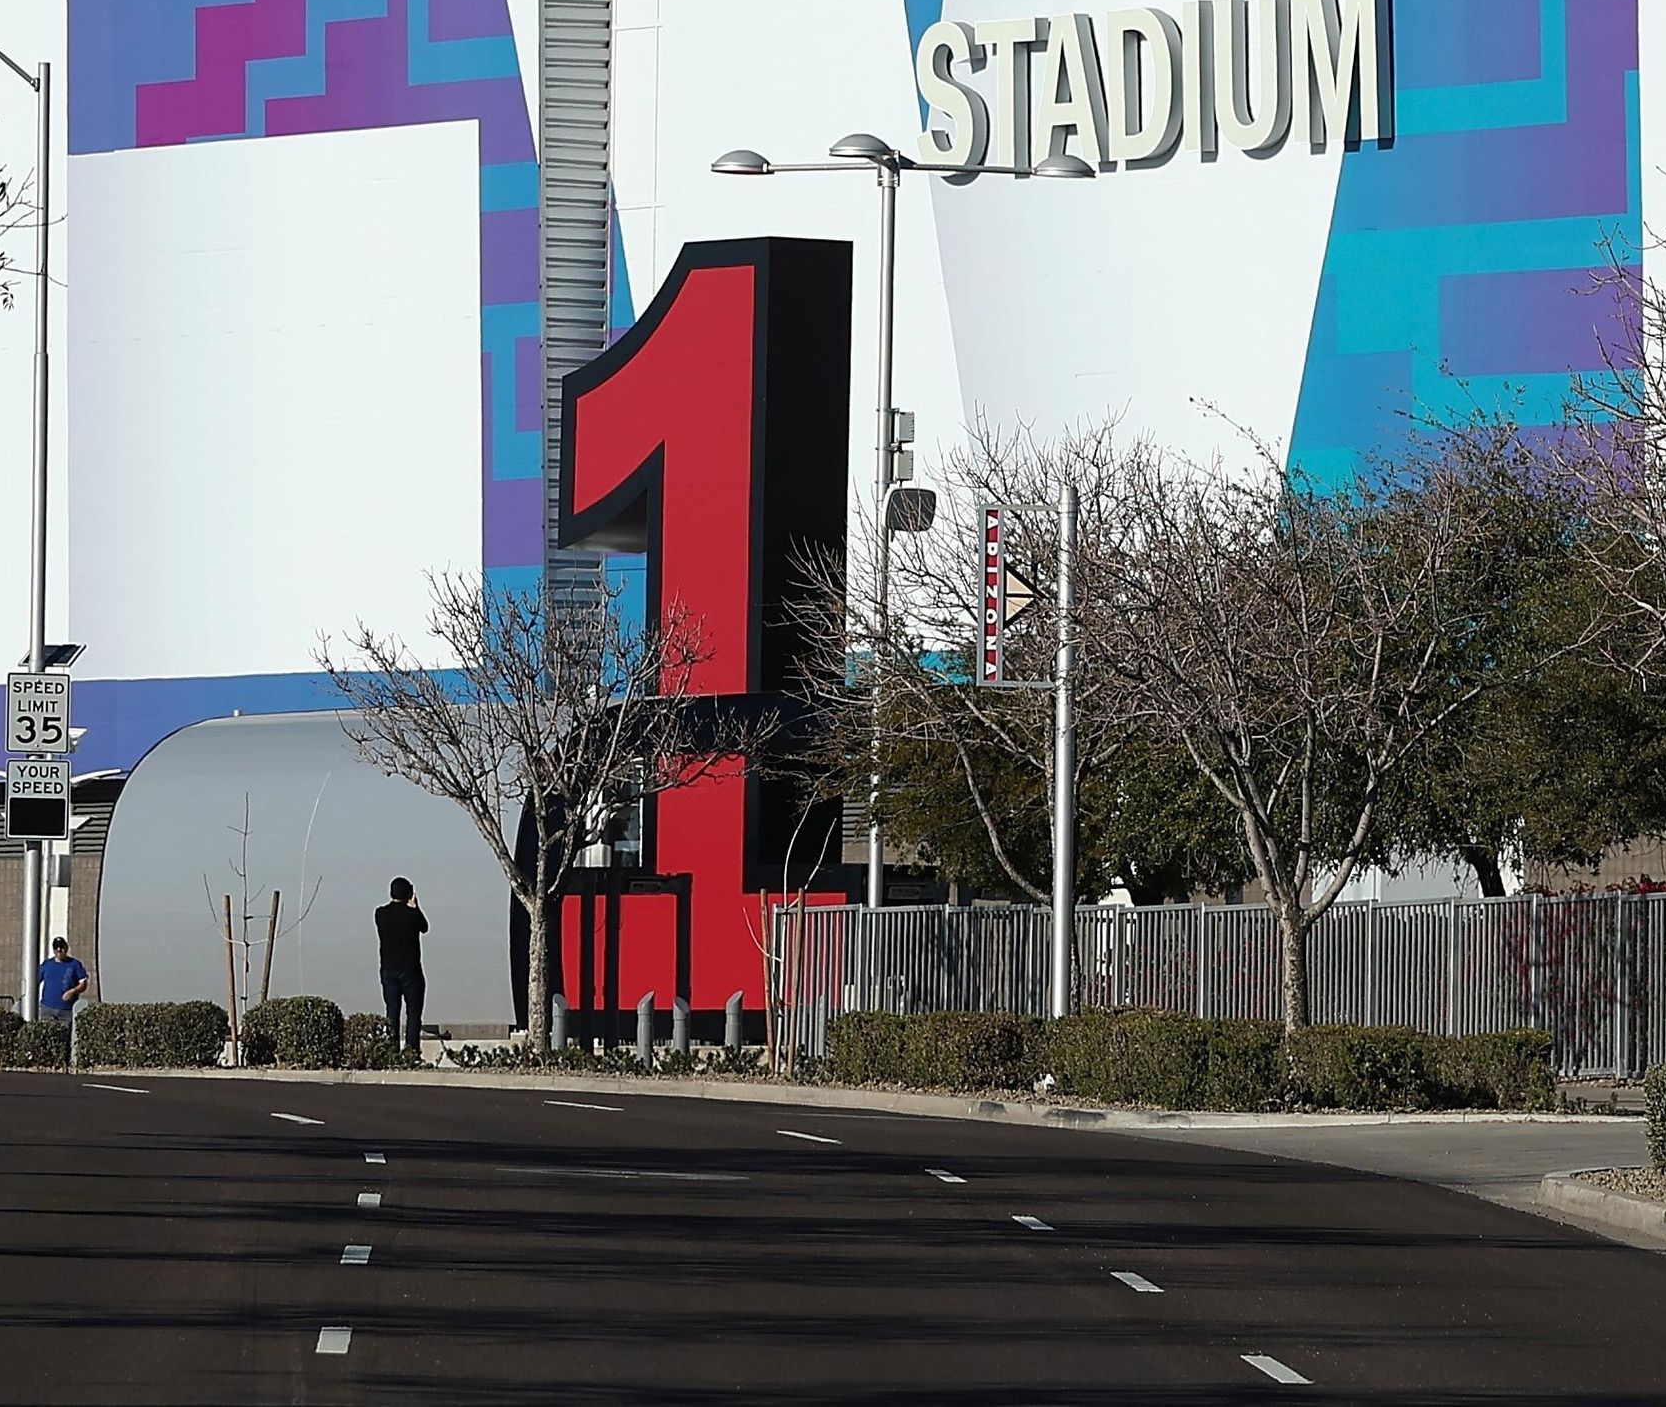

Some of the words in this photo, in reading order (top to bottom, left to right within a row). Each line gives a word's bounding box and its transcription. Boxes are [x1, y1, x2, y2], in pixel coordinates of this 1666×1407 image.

[986, 515, 999, 675] ARIZONA
[13, 681, 65, 694] SPEED
[18, 699, 59, 713] LIMIT
[15, 715, 63, 744] 35
[17, 765, 60, 778] YOUR
[12, 782, 64, 794] SPEED
